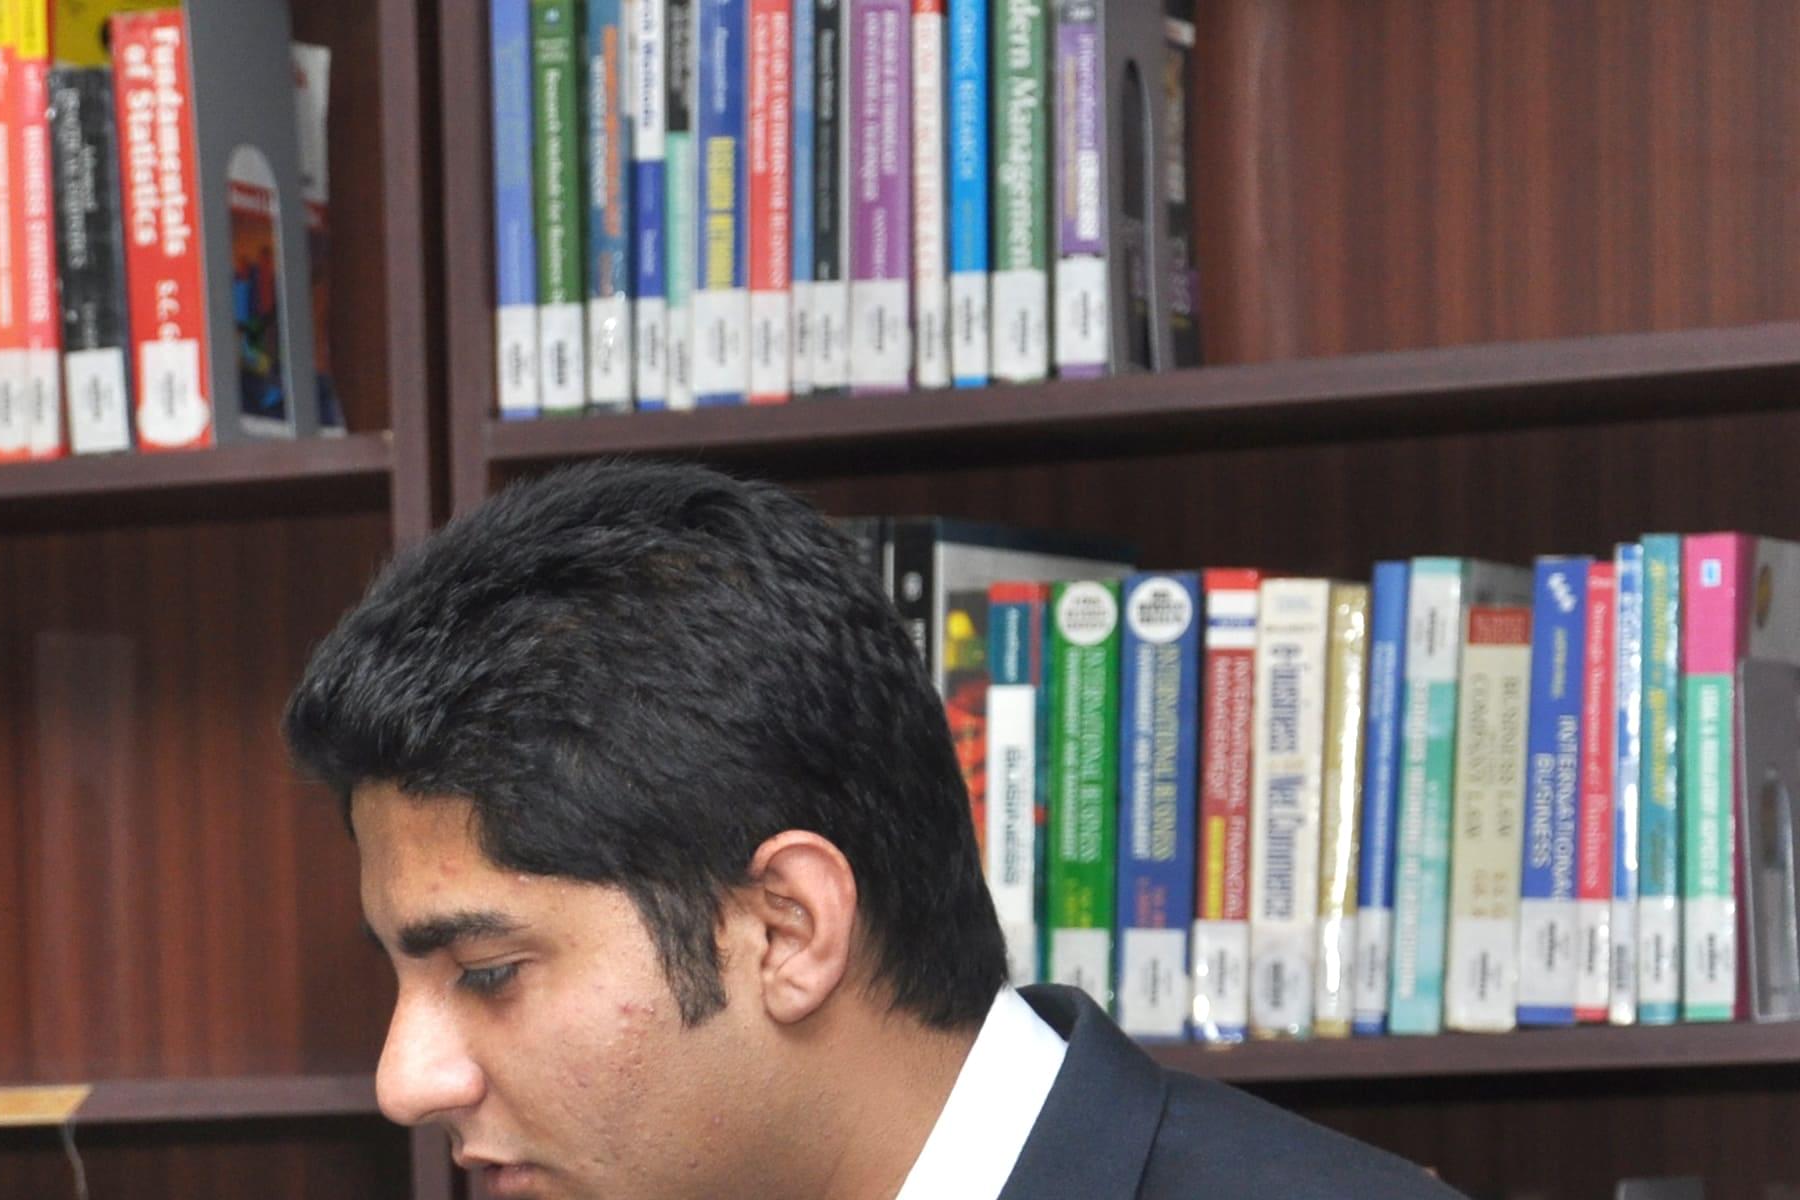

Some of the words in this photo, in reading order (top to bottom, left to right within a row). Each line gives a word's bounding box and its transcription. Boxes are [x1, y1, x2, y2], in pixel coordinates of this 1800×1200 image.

[123, 43, 152, 79] of
[126, 89, 159, 246] Statistics
[150, 26, 190, 258] Fundamentals
[1228, 656, 1251, 808] INTERNATIONAL
[1003, 745, 1025, 887] BUSINESS
[1224, 814, 1248, 920] FINANCIAL
[1531, 752, 1554, 870] BUSINESS
[1585, 793, 1608, 889] Business
